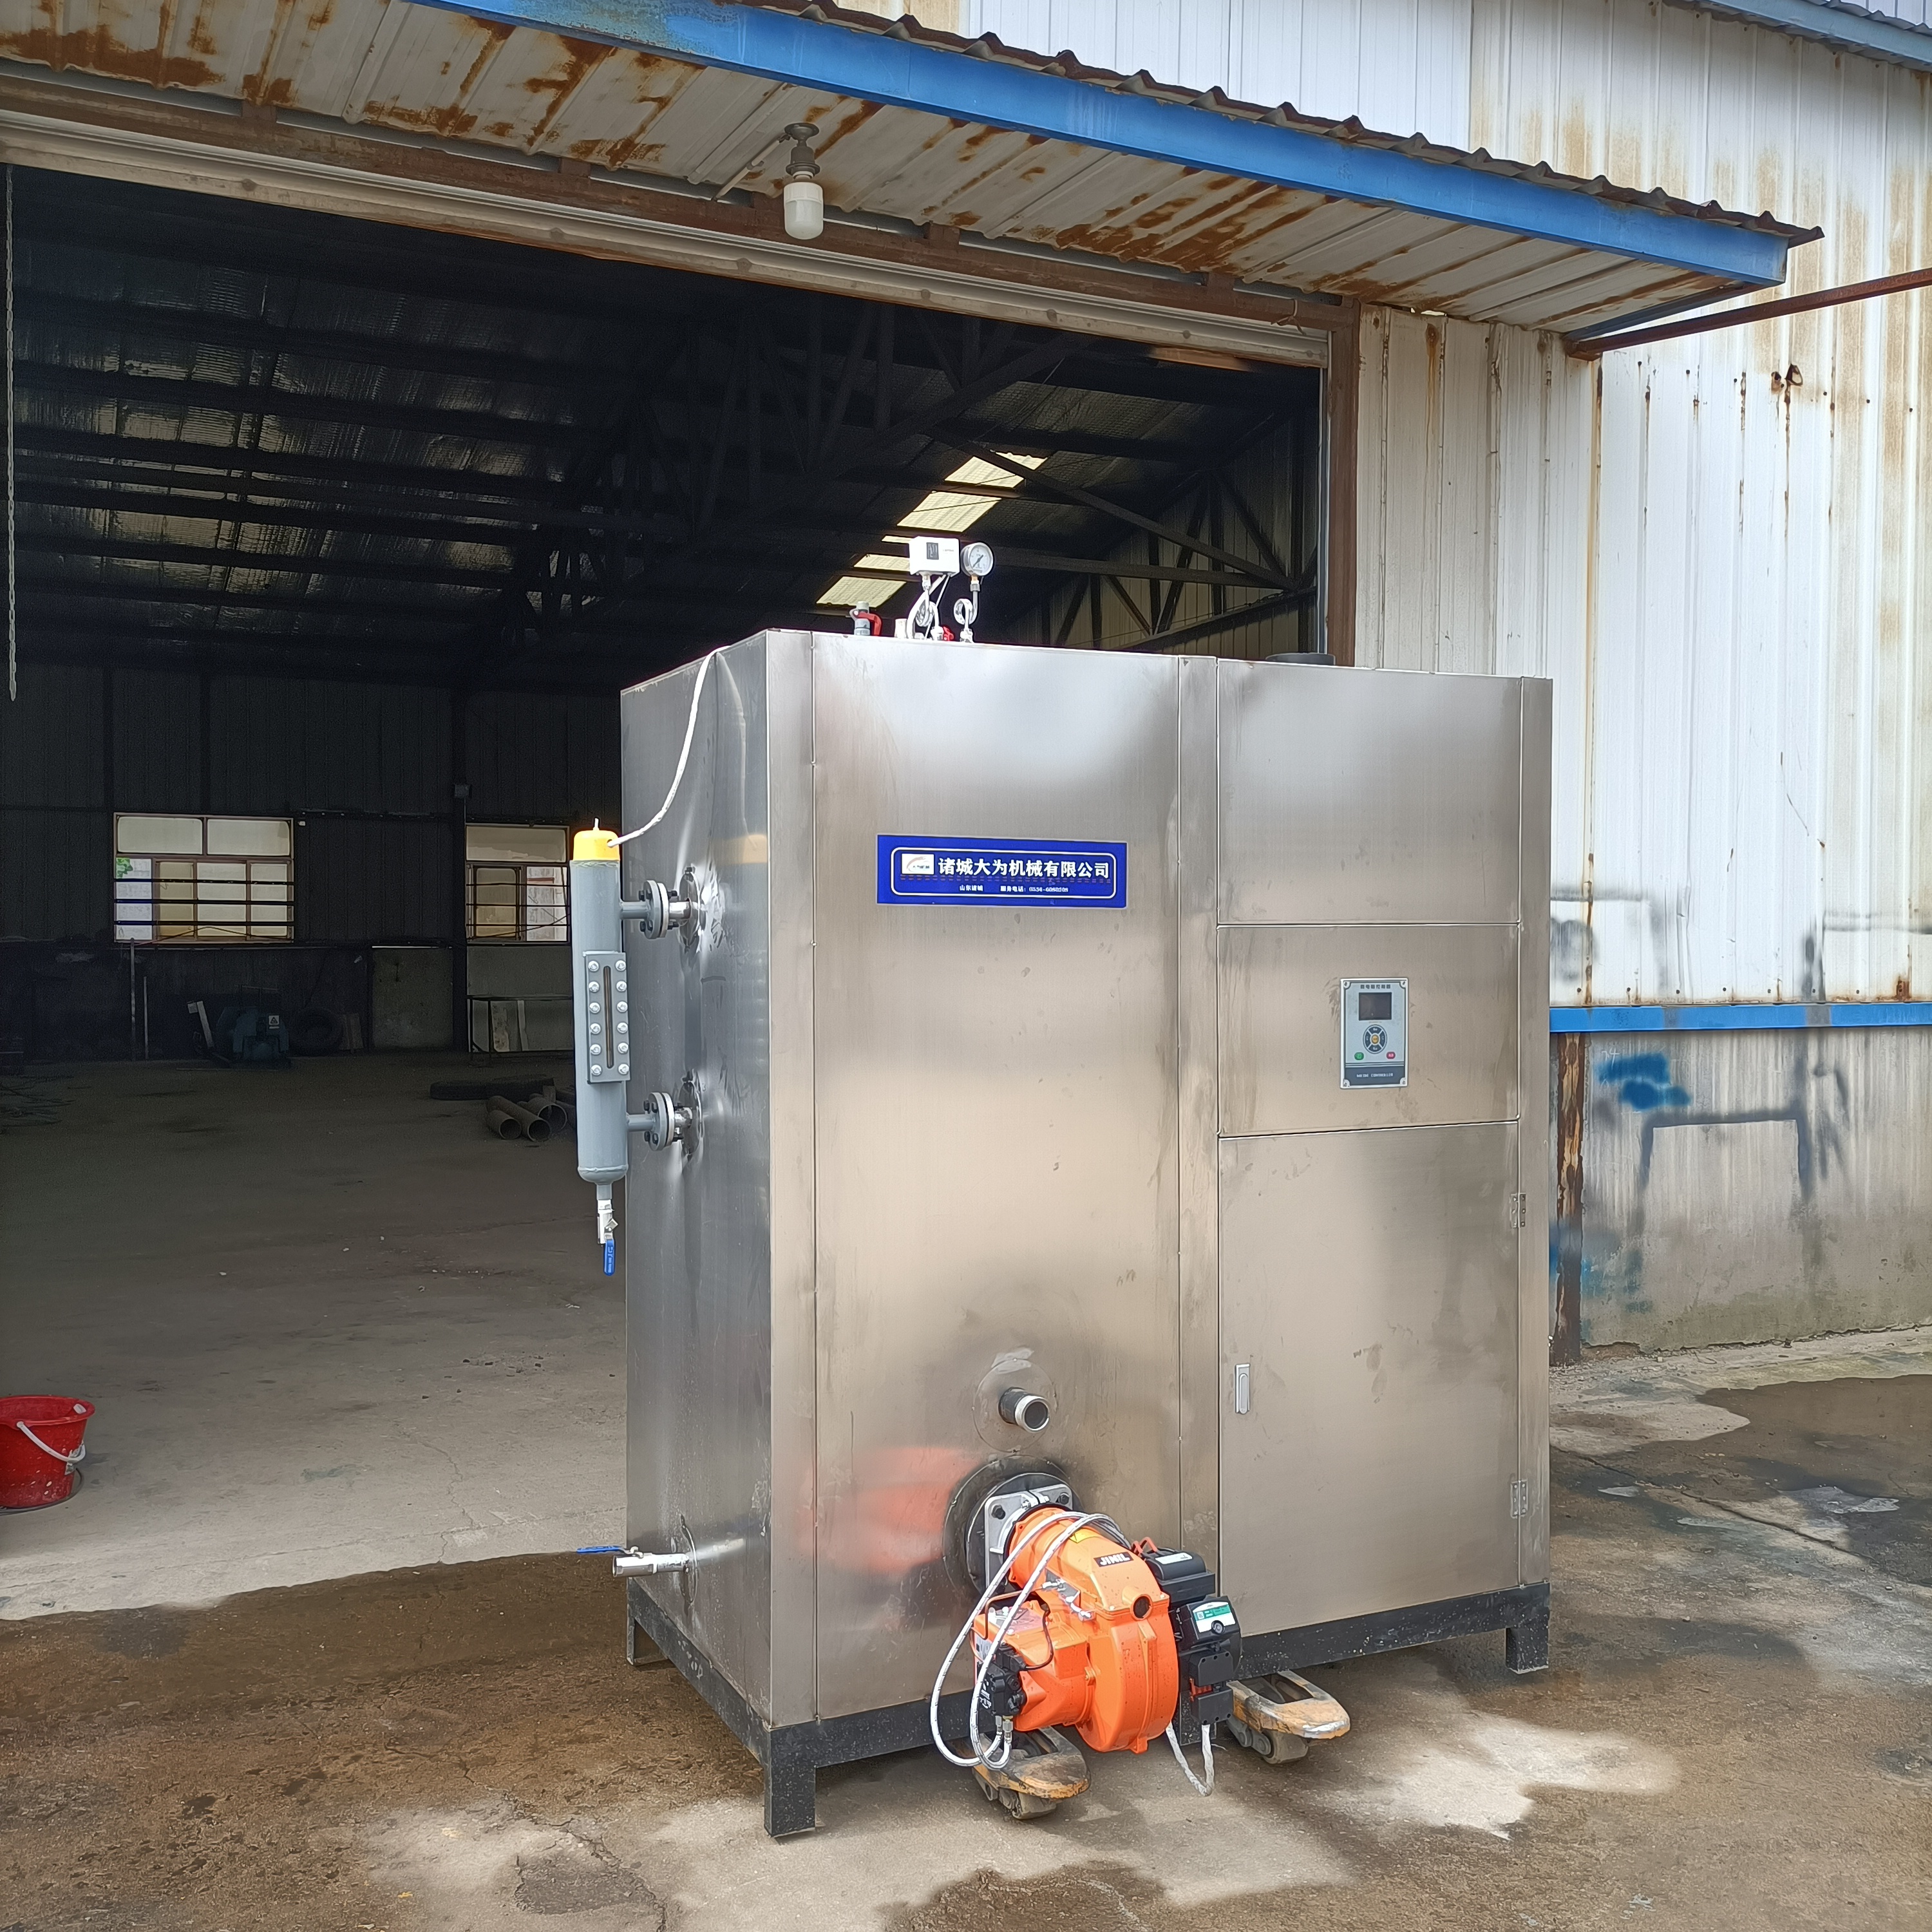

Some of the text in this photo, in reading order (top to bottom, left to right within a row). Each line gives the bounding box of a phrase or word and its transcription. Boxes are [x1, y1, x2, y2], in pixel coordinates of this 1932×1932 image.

[938, 858, 1109, 879] 诸城大为机械有限公司
[1100, 1553, 1131, 1566] JINIL
